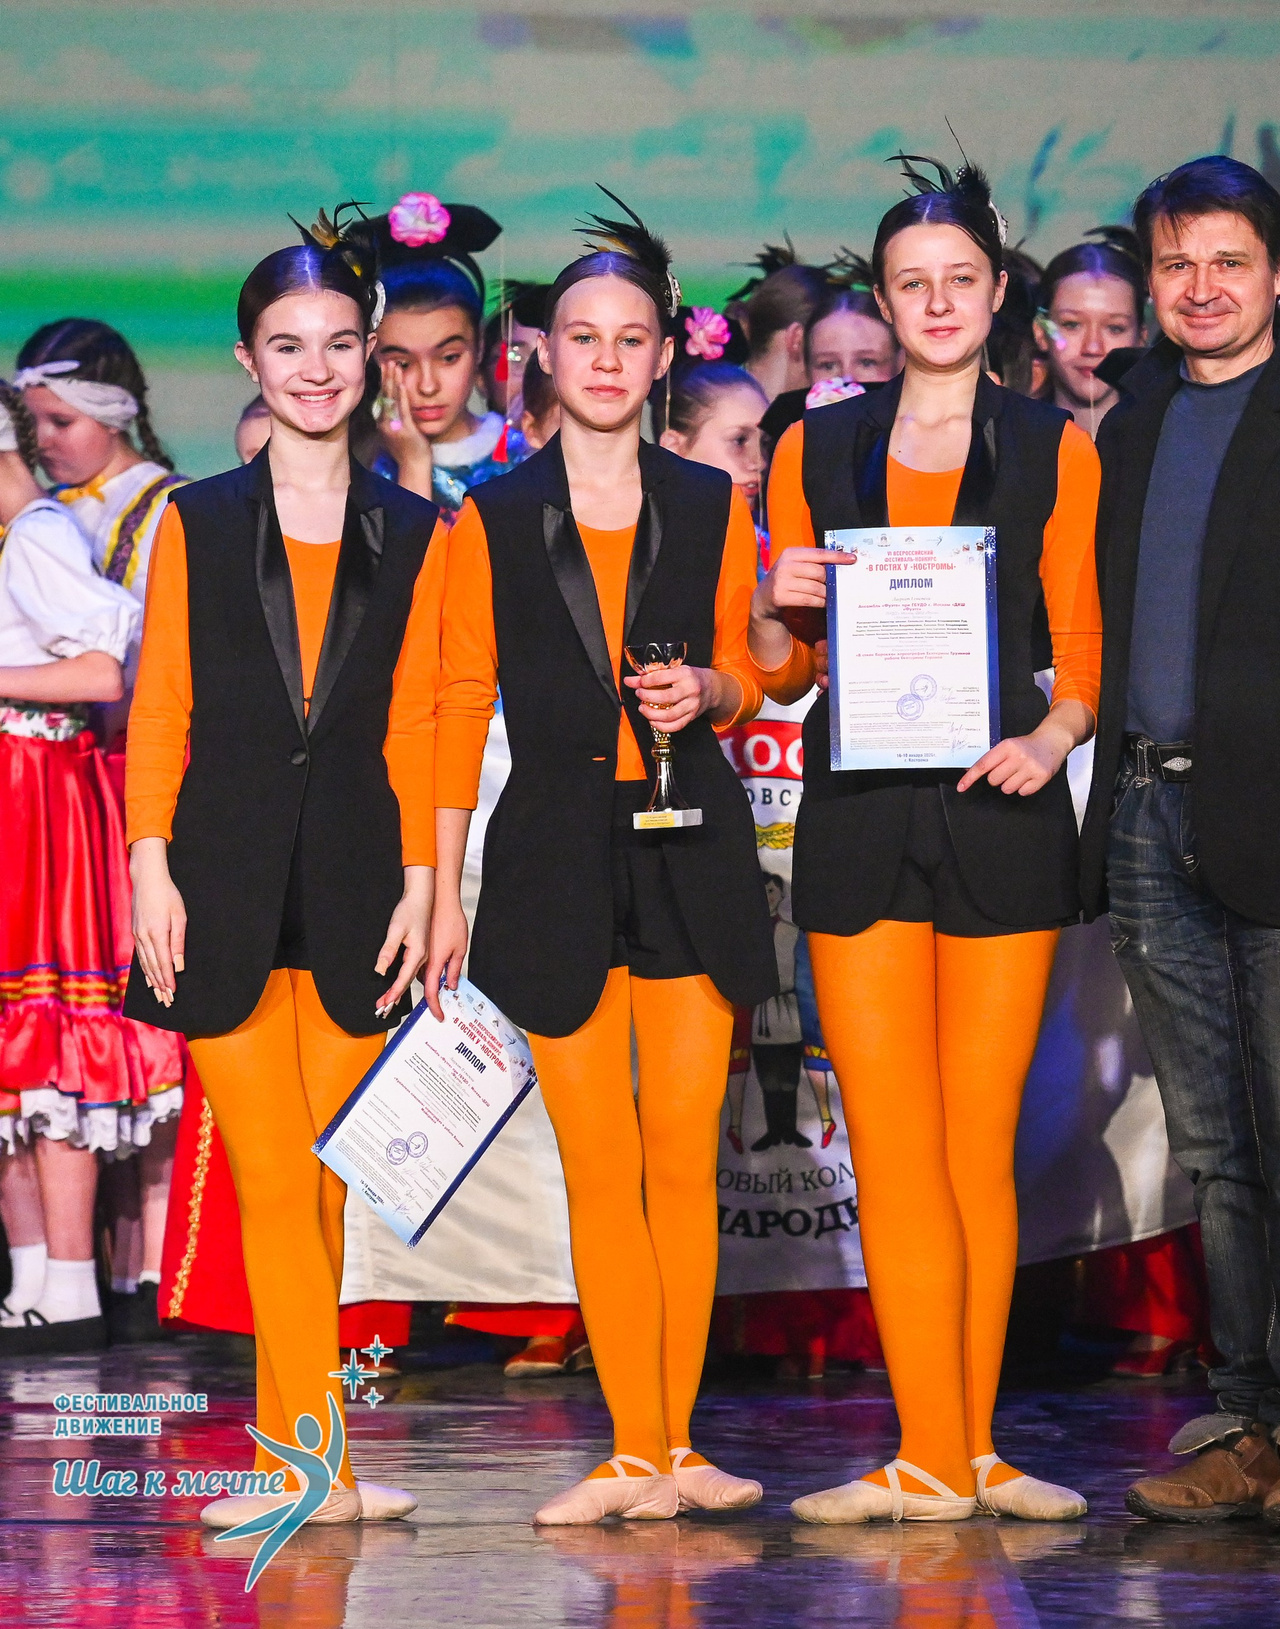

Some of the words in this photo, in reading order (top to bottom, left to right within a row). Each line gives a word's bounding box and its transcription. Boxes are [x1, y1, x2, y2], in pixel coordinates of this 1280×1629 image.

[875, 563, 902, 571] ГОСТЯХ
[903, 563, 908, 571] У
[889, 578, 933, 590] ДИПЛОМ
[458, 1021, 476, 1041] ГОСТЯХ
[455, 1042, 487, 1074] ДИПЛОМ
